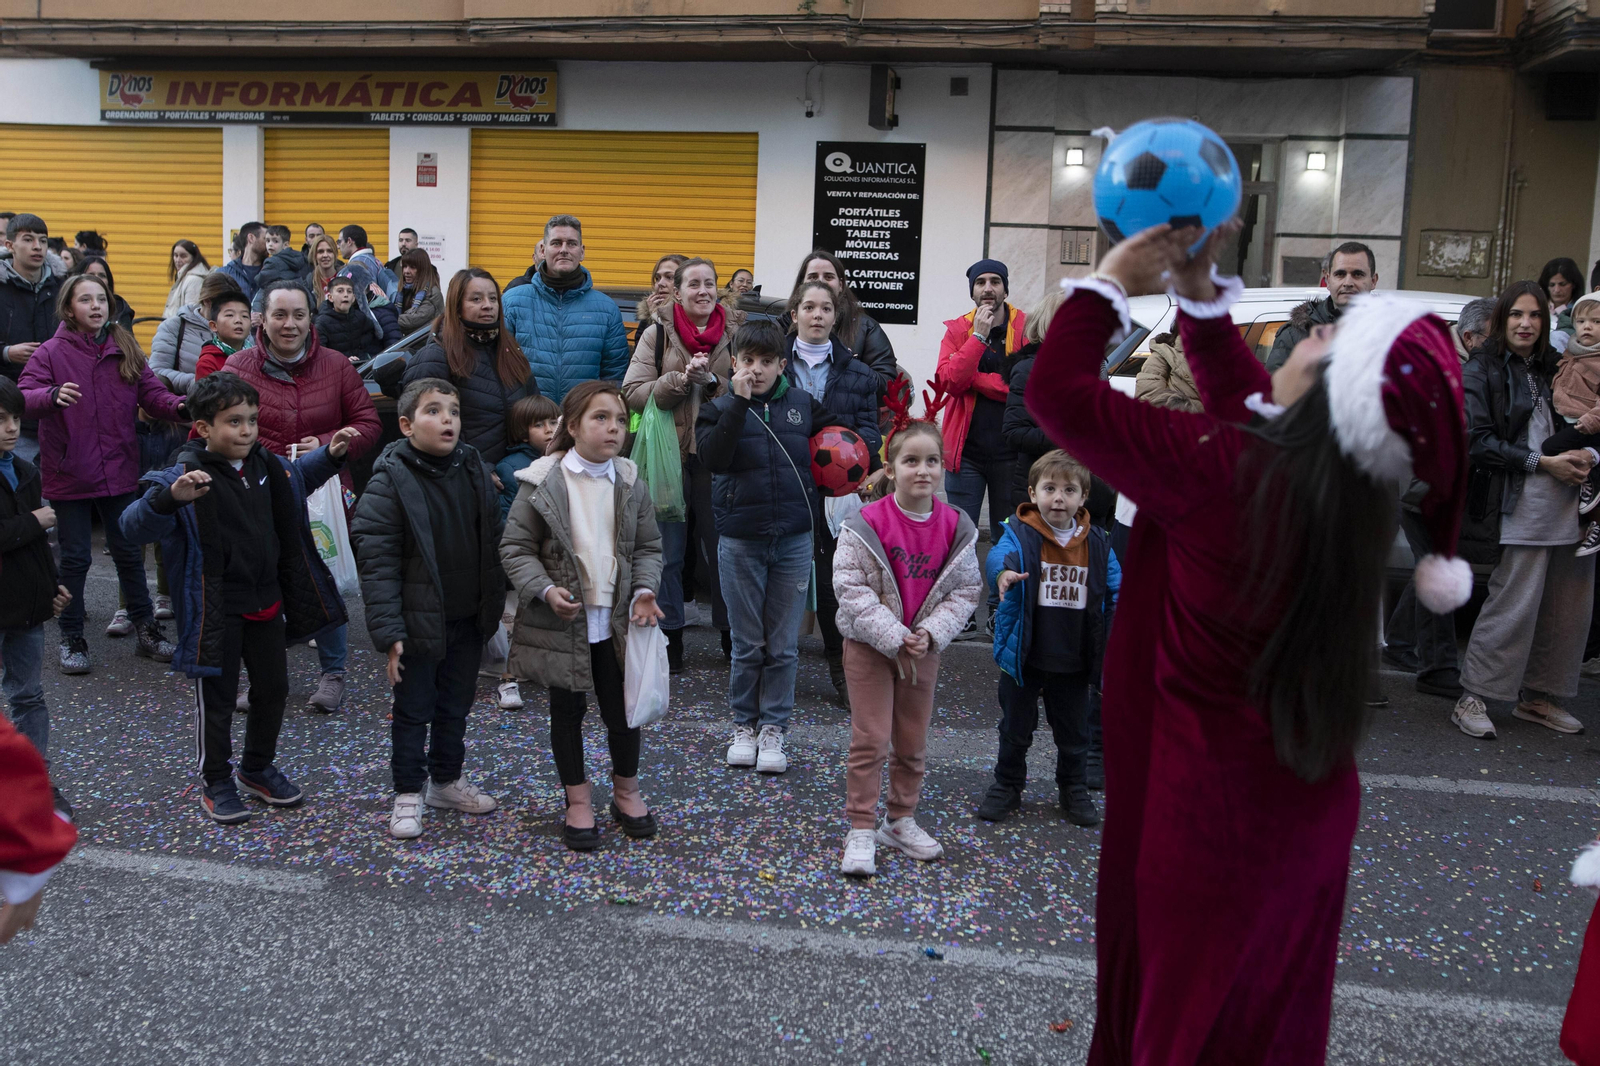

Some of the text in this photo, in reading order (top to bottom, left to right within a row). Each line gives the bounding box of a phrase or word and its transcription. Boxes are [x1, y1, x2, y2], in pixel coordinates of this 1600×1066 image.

[165, 74, 483, 107] INFORMÁTICA
[105, 111, 159, 120] ORDENADORES
[164, 110, 210, 120] PORTÁTILES
[215, 111, 265, 121] IMPRESORAS
[370, 112, 550, 123] TABLETS CONSOLAS SONIDO IMAGEN TV
[824, 151, 917, 175] QUANTICA
[824, 175, 917, 185] SOLUCIONES INFORMÁTICAS S.L.
[826, 190, 852, 198] VENTA
[858, 191, 907, 200] REPARACIÓN
[907, 192, 920, 200] DE:
[838, 206, 901, 218] PORTÁTILES
[830, 218, 909, 229] ORDENADORES
[846, 229, 891, 239] TABLETS
[845, 239, 891, 250] MÓVILES
[834, 250, 900, 261] IMPRESORAS
[852, 269, 916, 280] CARTUCHOS
[859, 281, 866, 289] Y
[867, 281, 904, 291] TONER
[857, 301, 914, 310] CNICO PROPIO
[1045, 584, 1080, 602] TEAM
